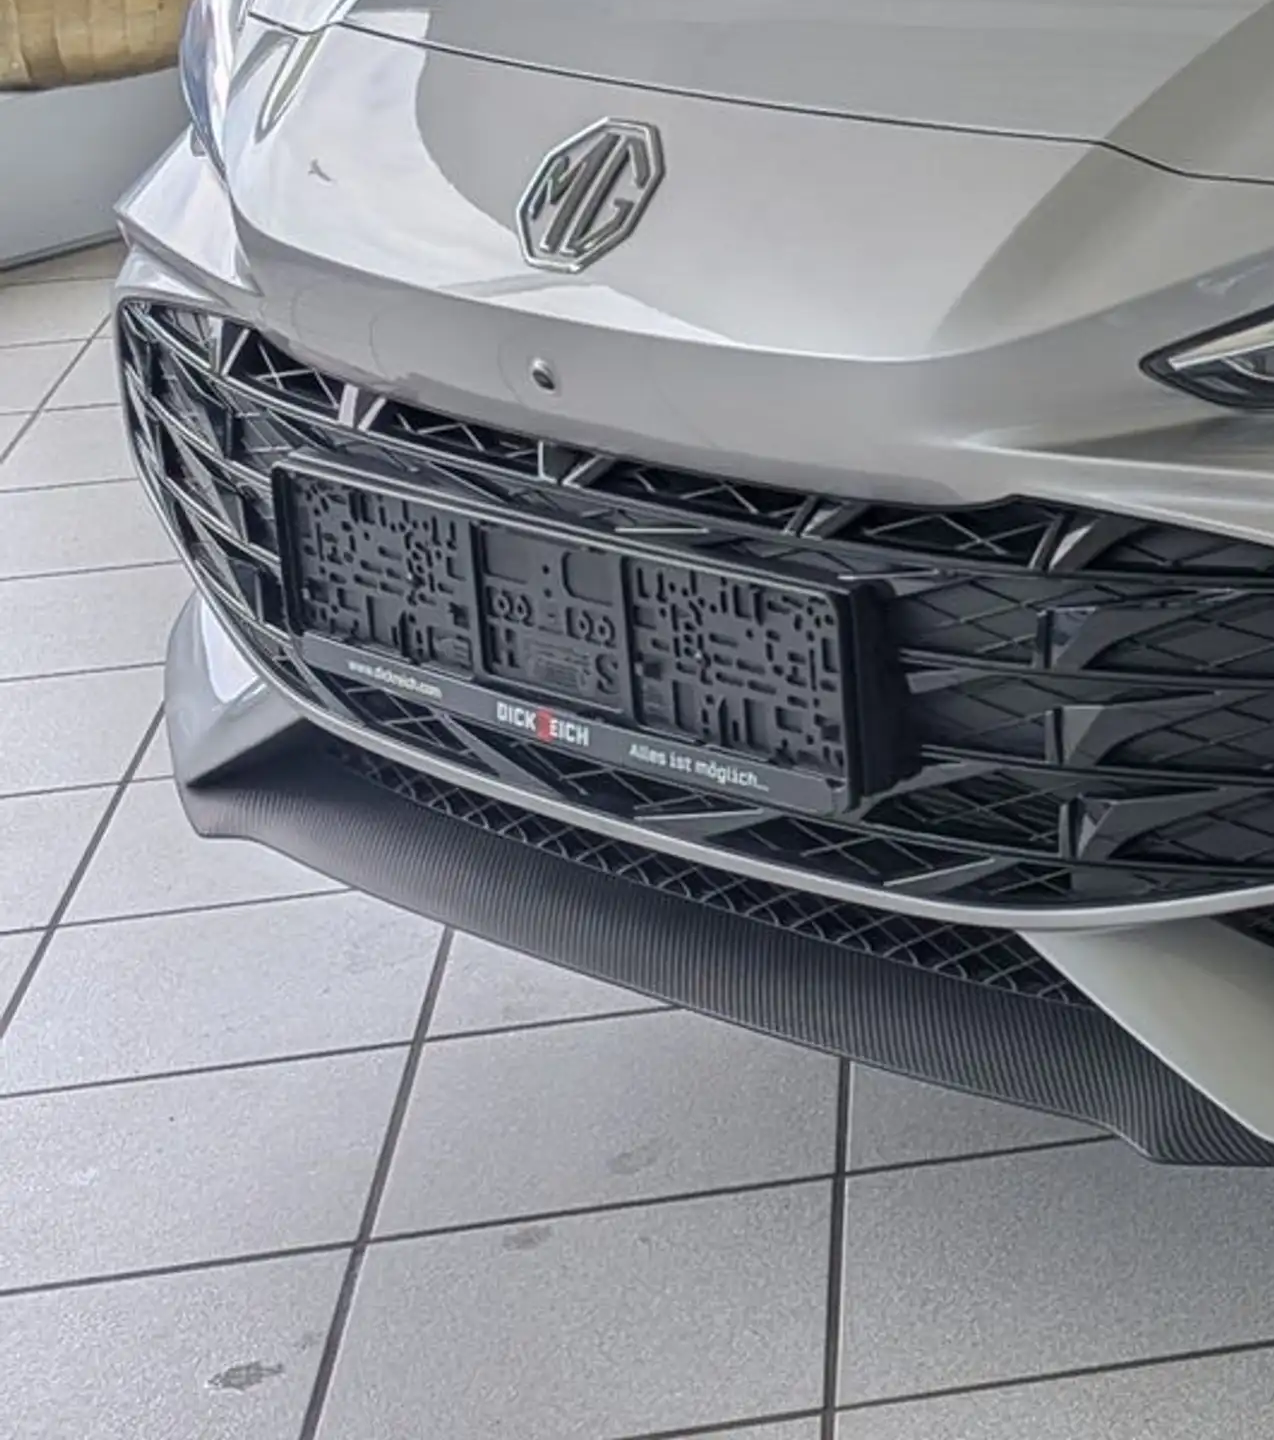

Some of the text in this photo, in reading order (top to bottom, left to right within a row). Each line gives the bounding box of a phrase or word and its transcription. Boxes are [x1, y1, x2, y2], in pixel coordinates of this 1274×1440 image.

[529, 132, 653, 258] MG
[628, 743, 666, 766] Alles
[669, 750, 693, 773] ist
